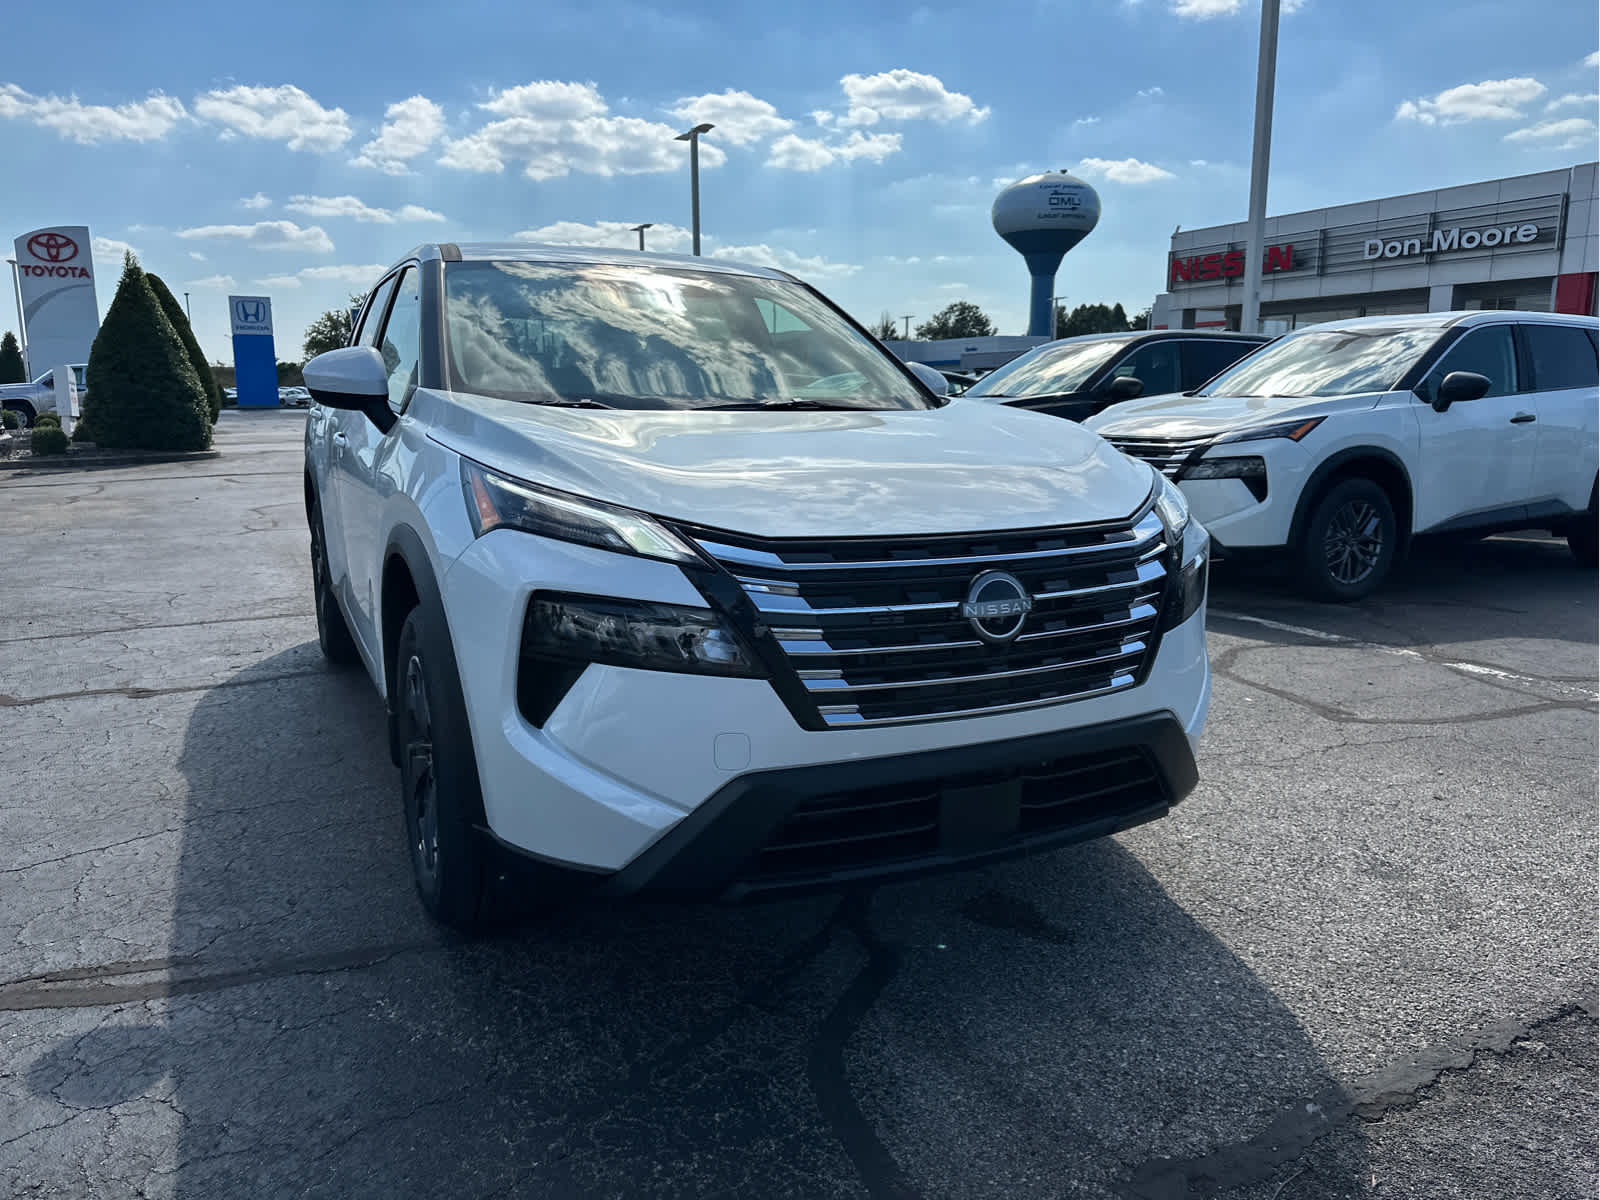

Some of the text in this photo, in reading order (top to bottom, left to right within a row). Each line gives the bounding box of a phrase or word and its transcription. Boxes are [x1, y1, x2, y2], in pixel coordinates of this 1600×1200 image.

[1363, 223, 1539, 260] Don Moore
[20, 264, 91, 279] TOYOTA
[1171, 244, 1294, 282] NISSN
[965, 600, 1032, 617] NISSAN
